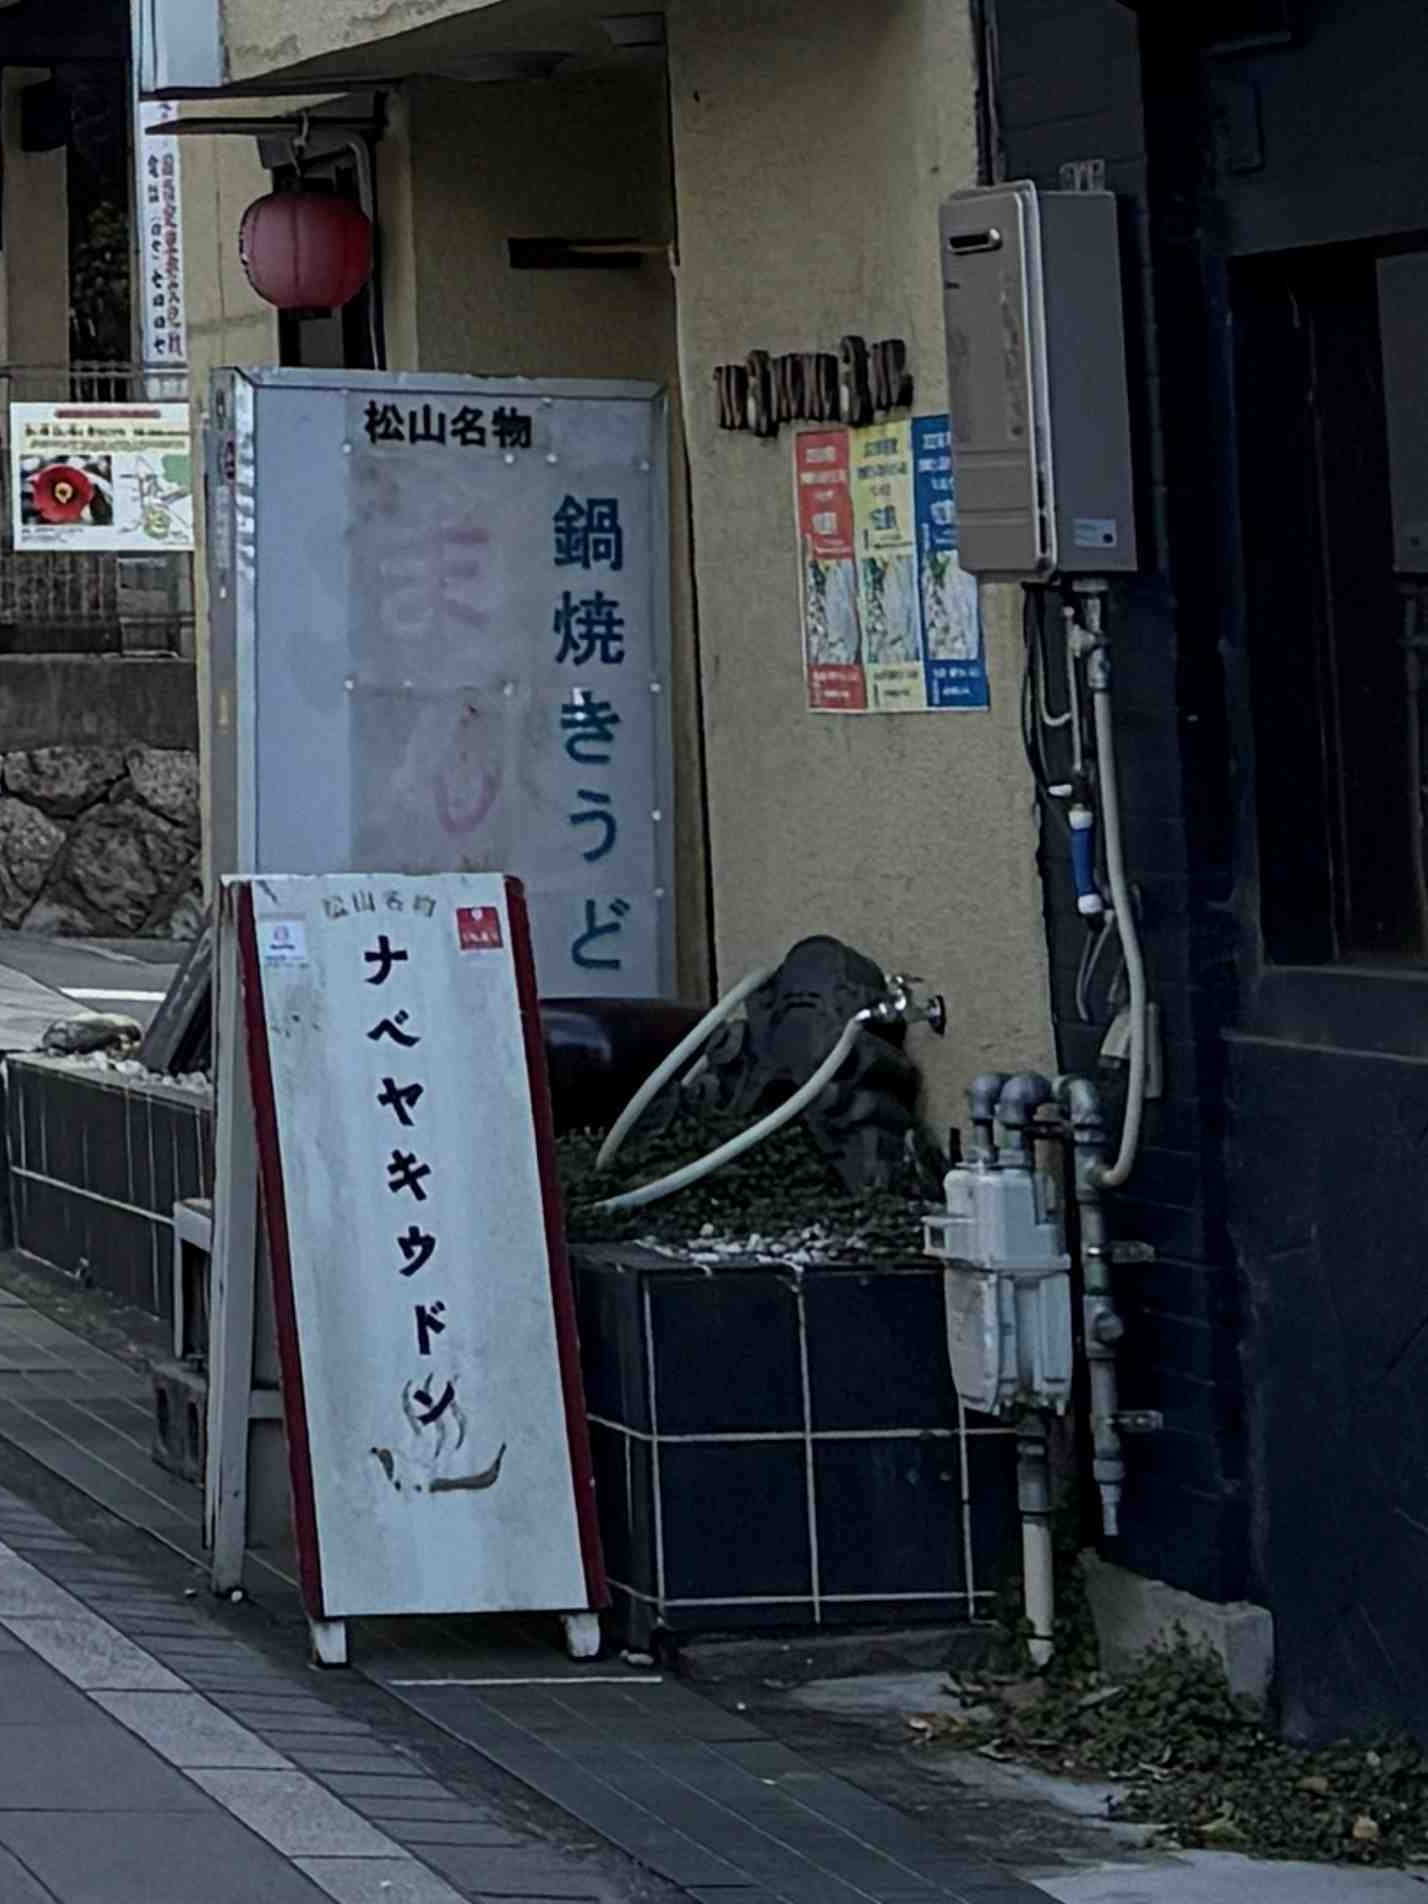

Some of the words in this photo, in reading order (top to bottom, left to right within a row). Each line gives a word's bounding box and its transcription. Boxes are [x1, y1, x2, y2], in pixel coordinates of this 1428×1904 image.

[363, 400, 533, 450] 松山名物
[551, 492, 632, 973] 鍋焼きうど
[364, 935, 456, 1426] ナベヤキウドン
